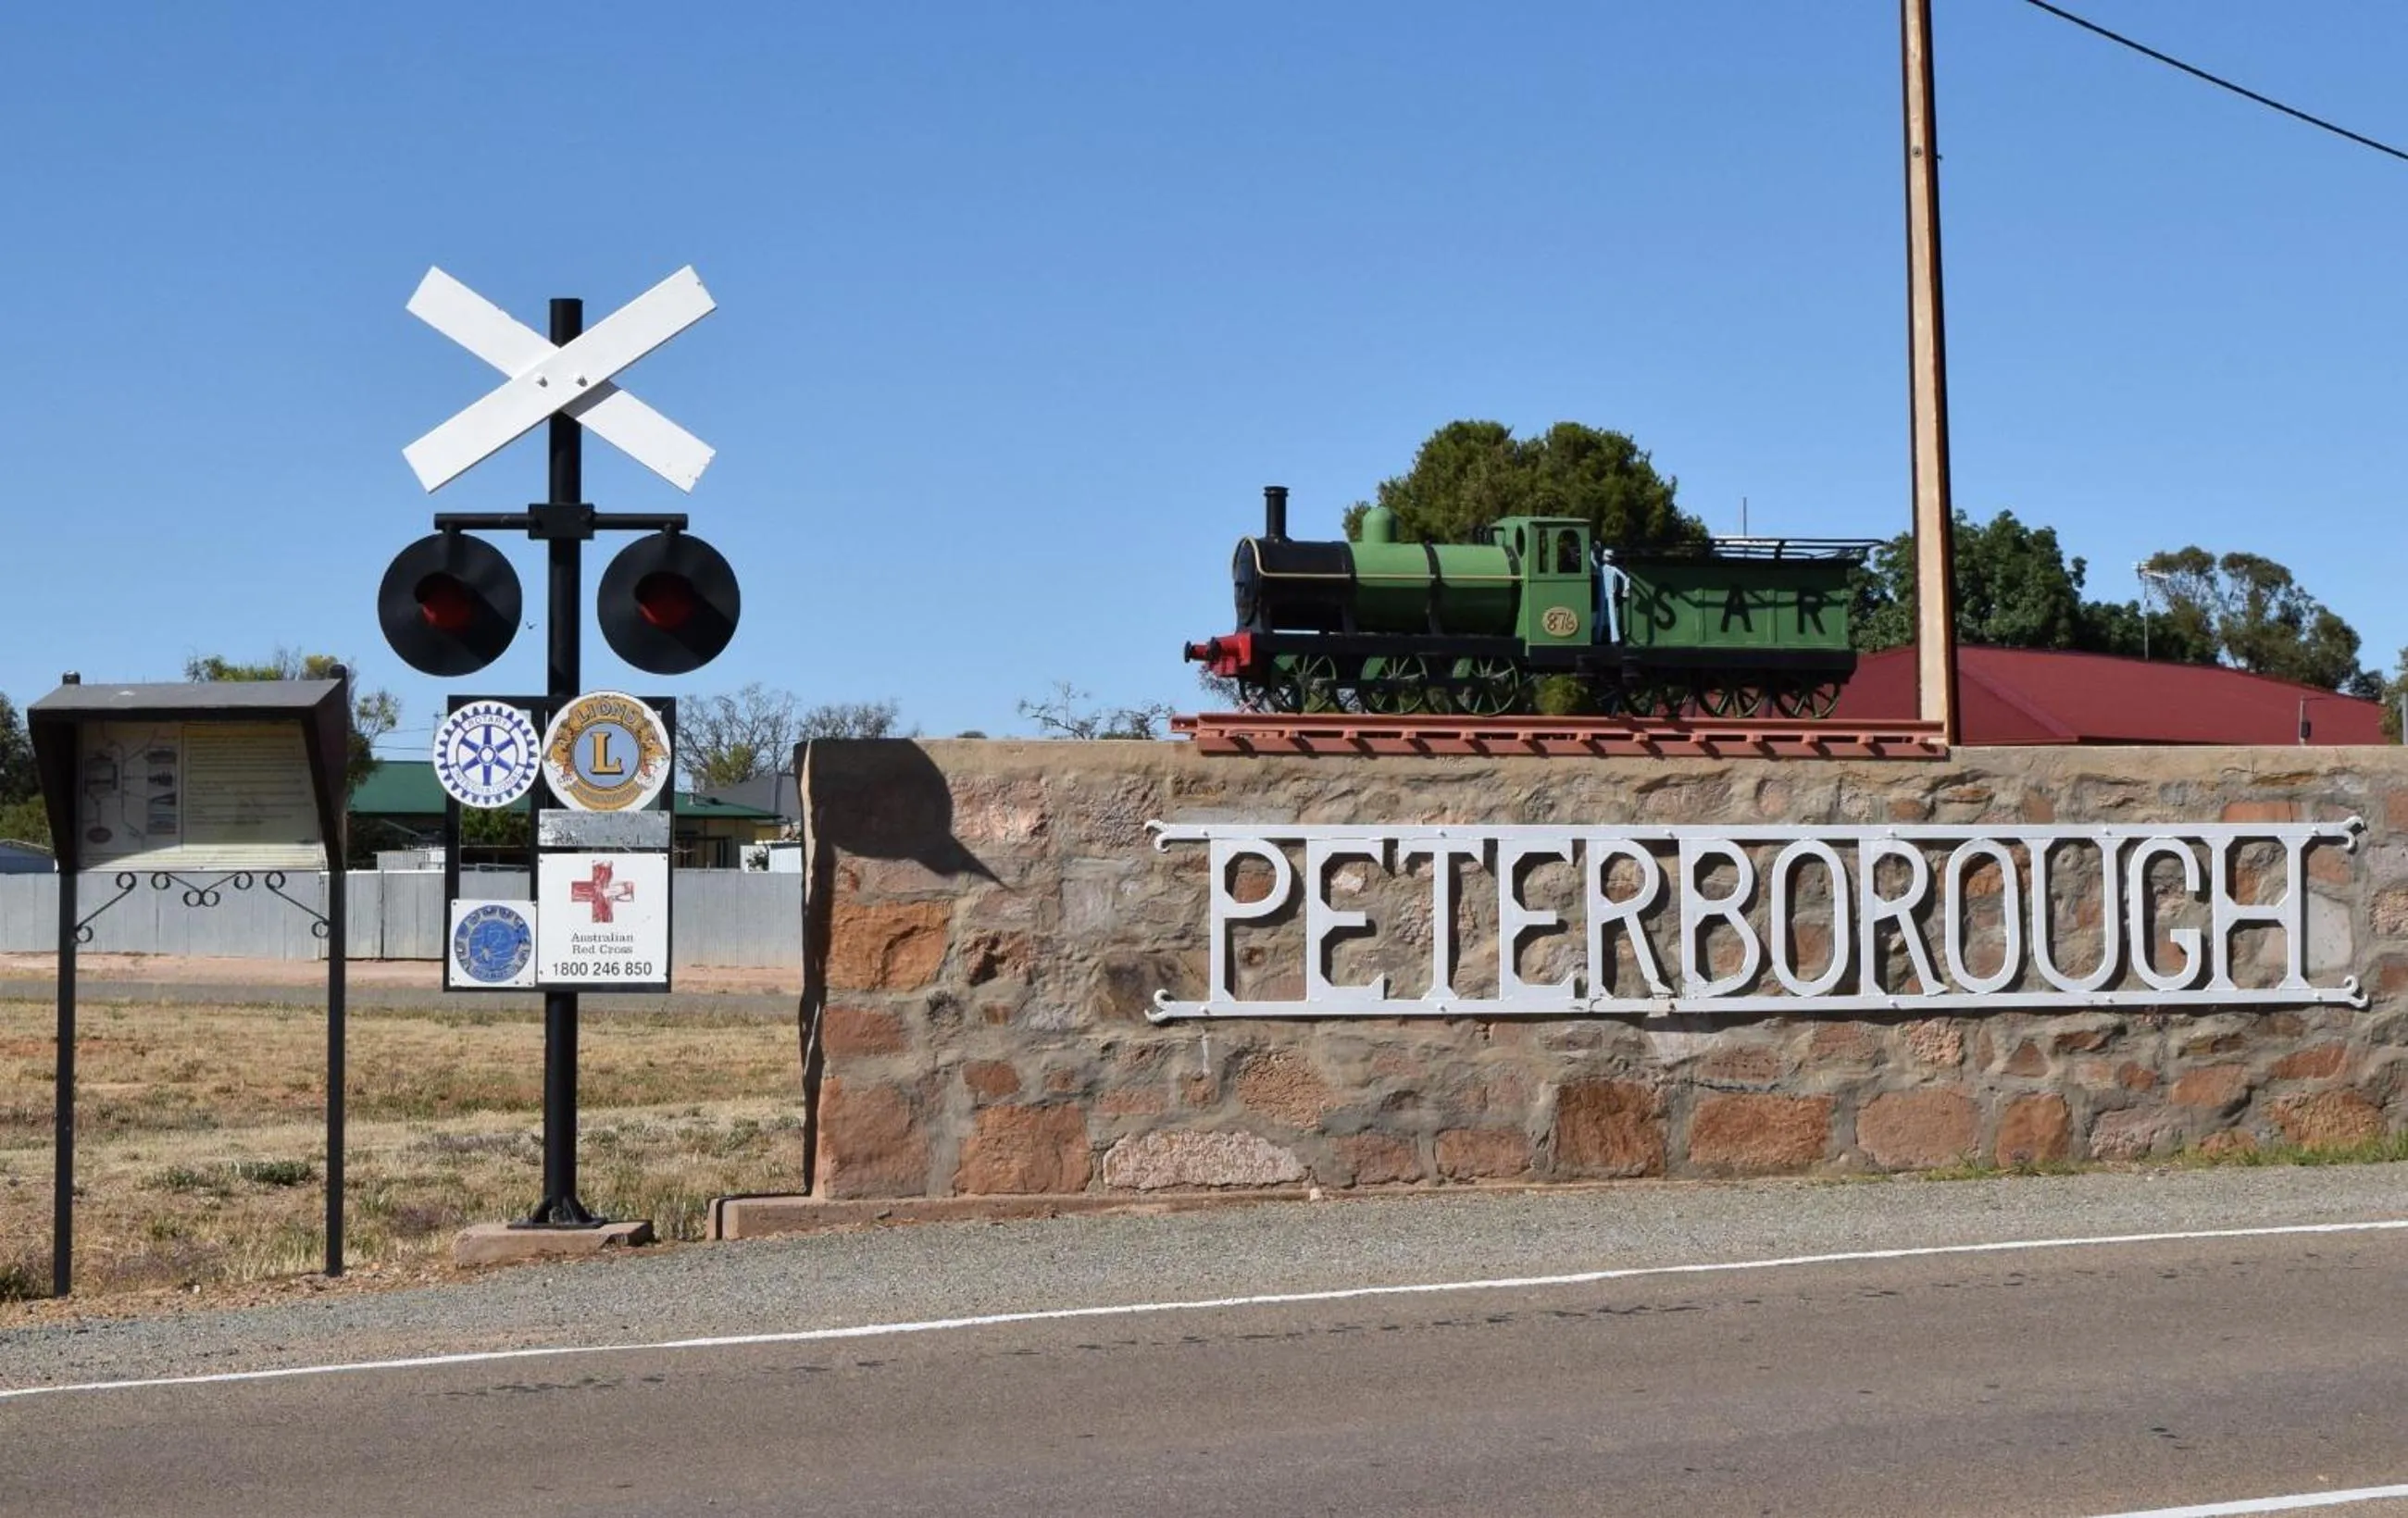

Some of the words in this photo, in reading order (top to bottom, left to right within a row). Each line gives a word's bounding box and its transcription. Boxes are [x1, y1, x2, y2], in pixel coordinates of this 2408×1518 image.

[1547, 612, 1576, 631] 876
[578, 702, 636, 723] LIONS
[468, 716, 508, 728] ROTARY
[590, 731, 624, 775] L
[1209, 836, 2312, 1002] PETERBOROUGH
[571, 932, 633, 943] Australian
[573, 944, 595, 954] Red
[599, 944, 633, 954] Cross
[553, 962, 588, 977] 1800
[593, 962, 619, 977] 246
[624, 962, 652, 977] 850
